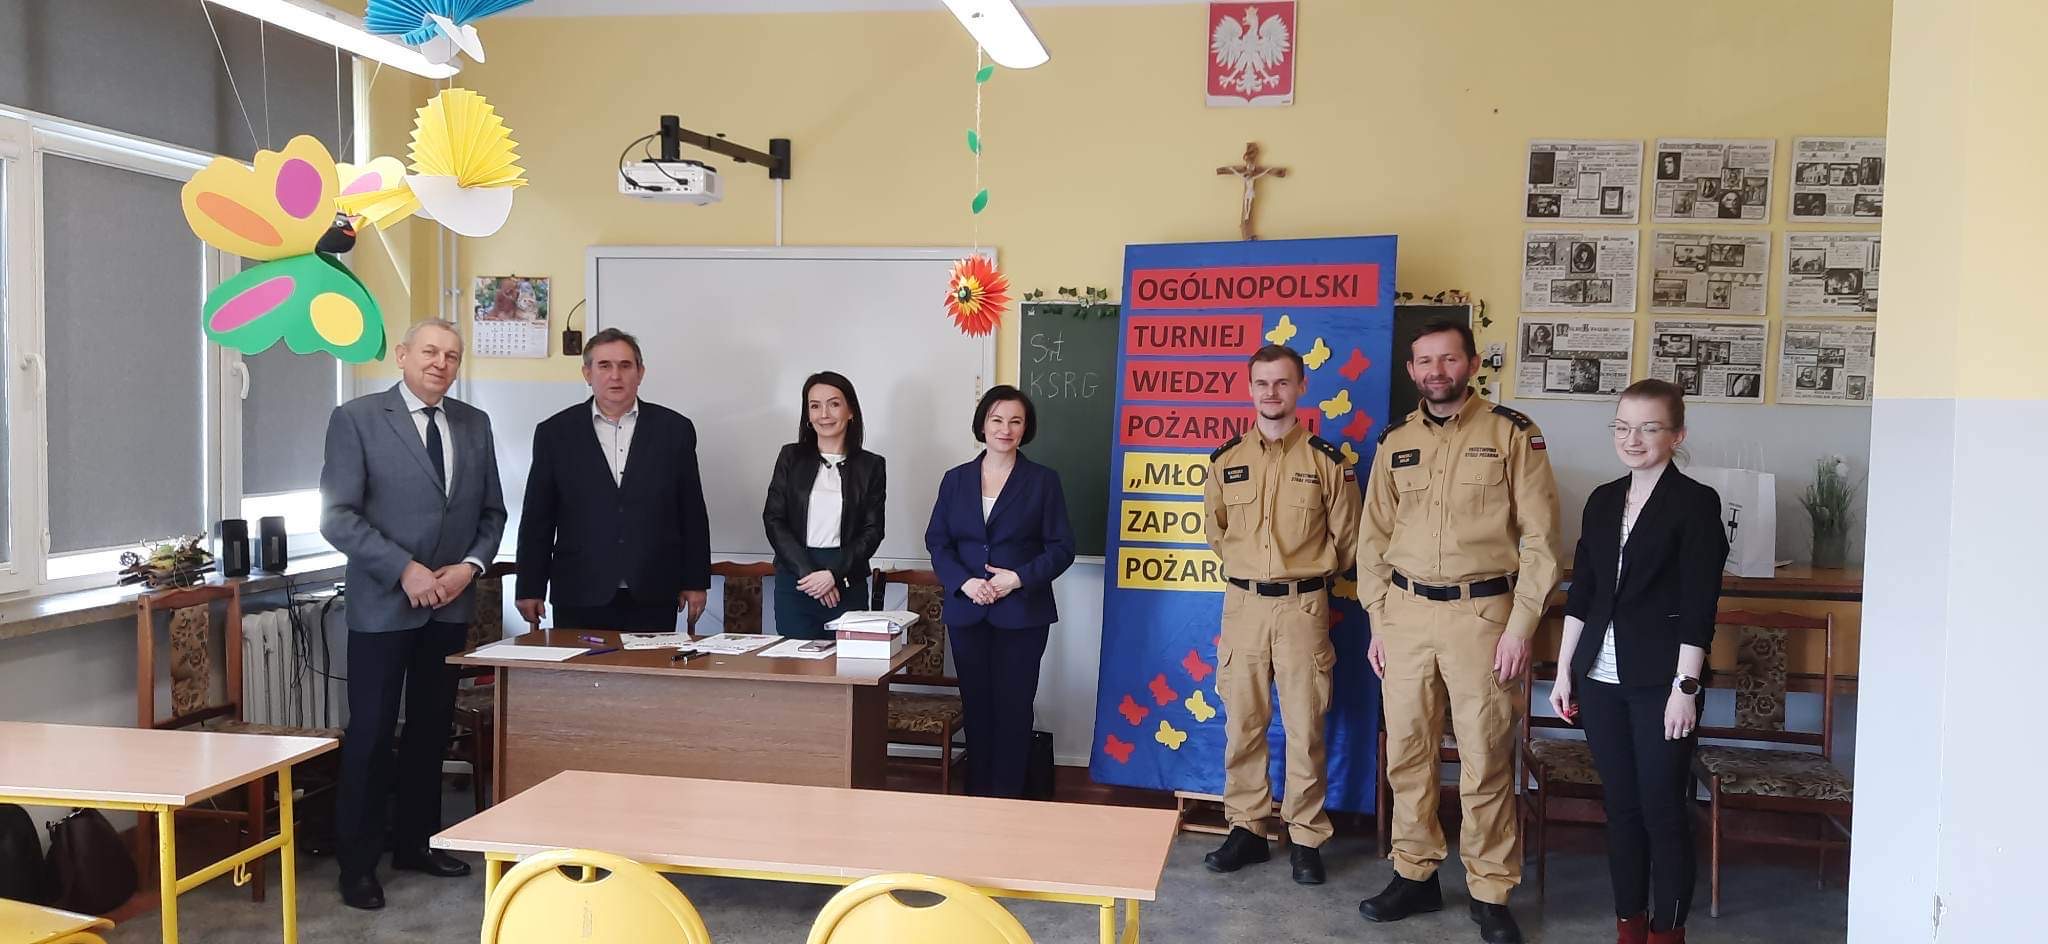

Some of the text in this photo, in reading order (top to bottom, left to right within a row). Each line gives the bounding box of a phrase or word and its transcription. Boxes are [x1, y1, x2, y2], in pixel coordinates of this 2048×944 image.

[1138, 272, 1359, 301] OGÓLNOPOLSKI
[1134, 325, 1245, 348] TURNIEJ
[1030, 371, 1100, 399] KSRG
[1132, 370, 1238, 394] WIEDZY
[1128, 410, 1314, 439] POŻARNIJ
[1129, 462, 1209, 489] „MŁO
[1127, 509, 1206, 535] ZAPO
